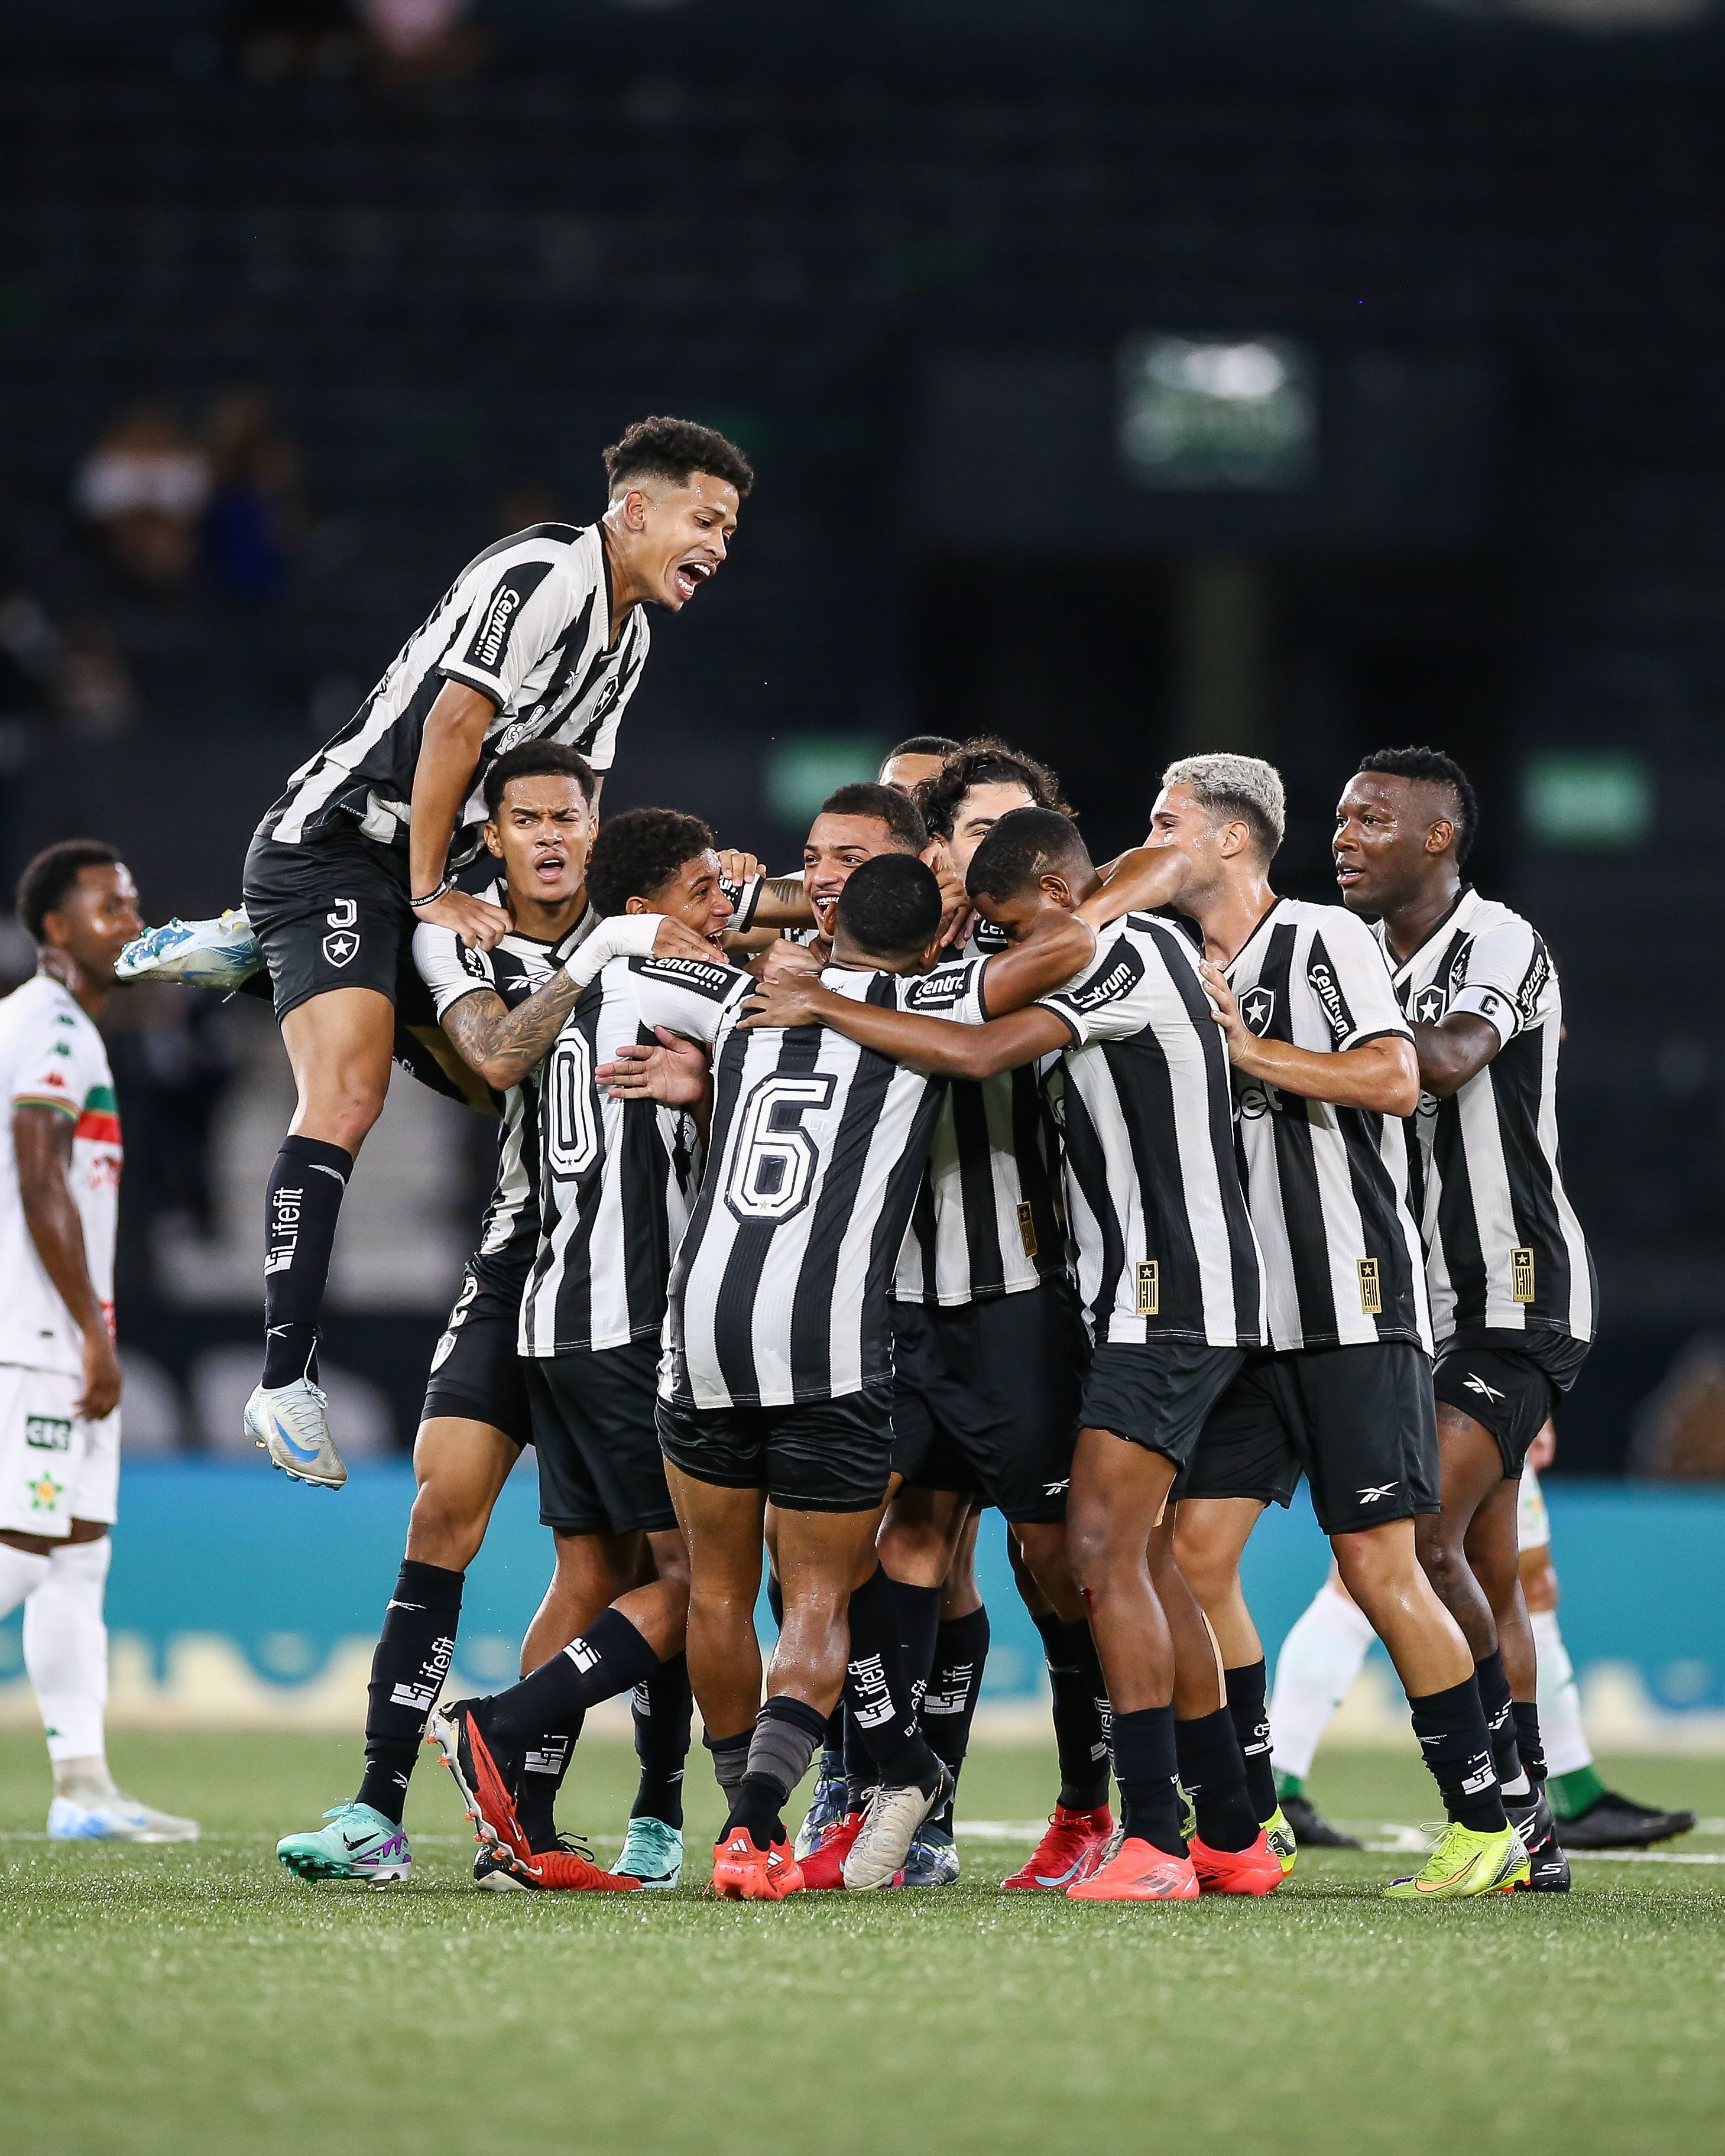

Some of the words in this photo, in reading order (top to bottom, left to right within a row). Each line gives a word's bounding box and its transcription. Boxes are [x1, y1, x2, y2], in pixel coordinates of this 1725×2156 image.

[480, 589, 520, 666] Centrum
[1478, 994, 1499, 1016] C
[539, 1026, 602, 1180] 0
[725, 1072, 838, 1224] 6
